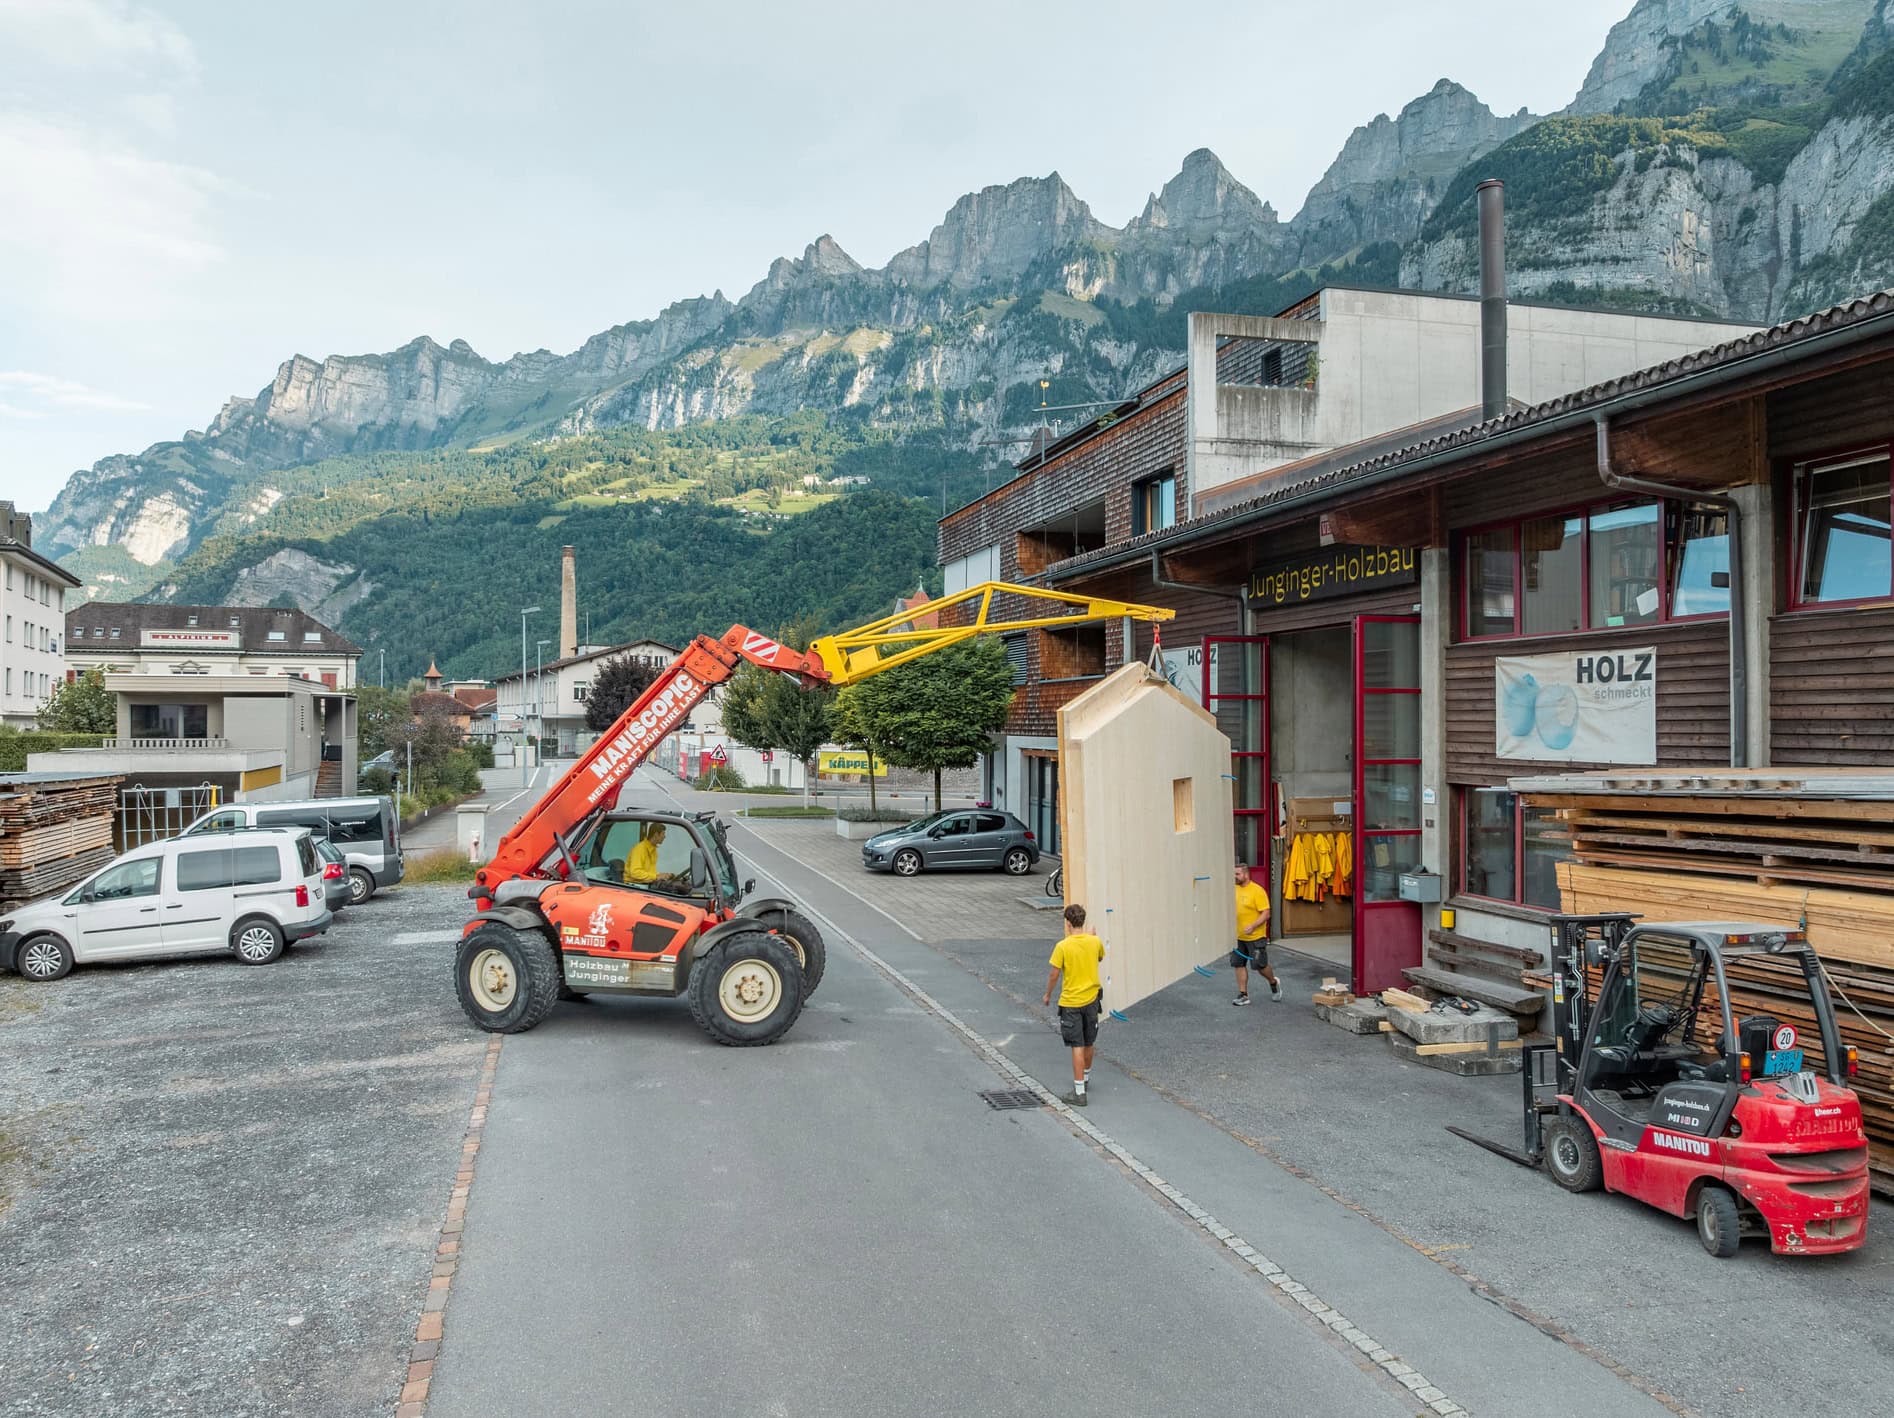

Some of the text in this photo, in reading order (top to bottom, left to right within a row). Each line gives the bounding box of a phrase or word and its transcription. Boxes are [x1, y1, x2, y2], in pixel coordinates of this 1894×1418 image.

[1248, 545, 1414, 602] Junginger-Holzbau
[1187, 648, 1216, 665] HOZ
[1576, 653, 1652, 683] HOLZ
[1594, 686, 1652, 699] schmeckt
[590, 674, 693, 779] MANISCOPIC
[587, 685, 701, 803] MEINE KRAFT FÜR IHRE LAST
[829, 757, 878, 769] KÄPPEI
[565, 935, 606, 948] MANITOU
[569, 960, 619, 972] Holzbau
[568, 970, 630, 983] Junginger
[1780, 1032, 1791, 1045] 20
[1780, 1052, 1791, 1061] SG
[1653, 1131, 1710, 1156] MANITOU
